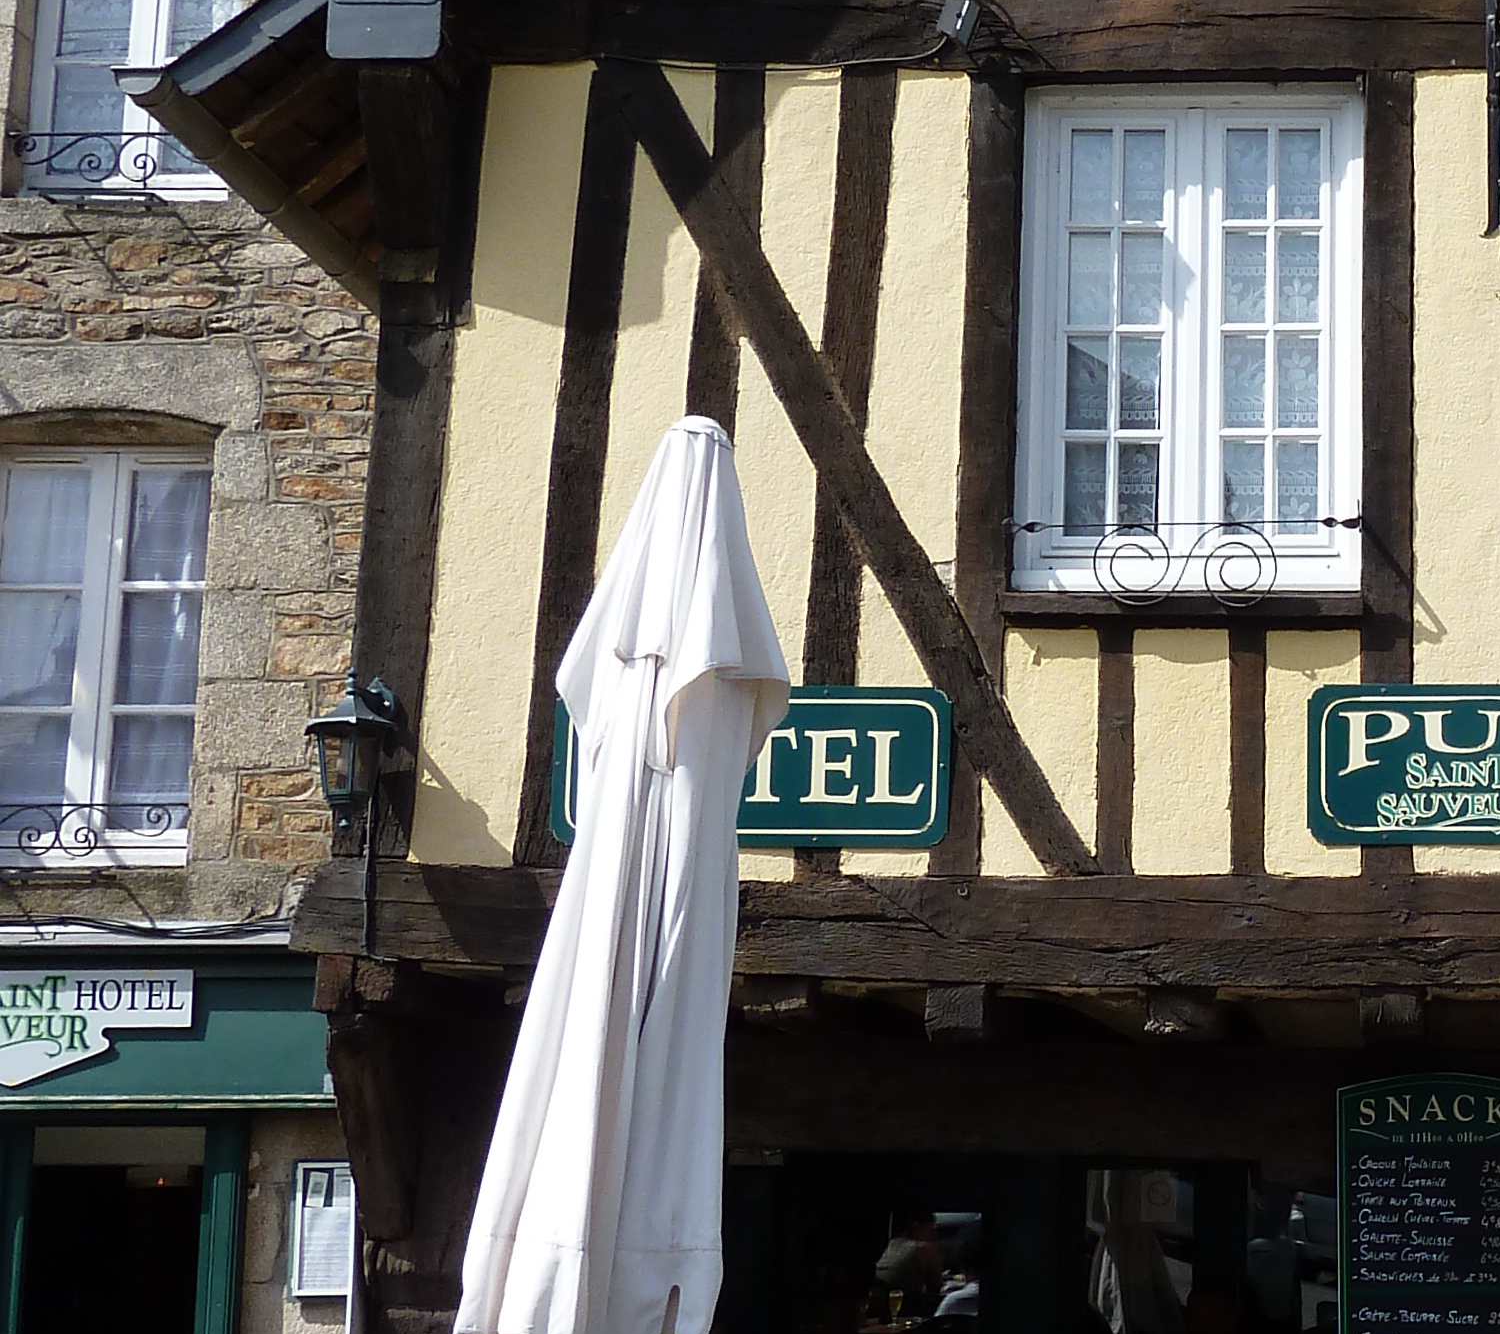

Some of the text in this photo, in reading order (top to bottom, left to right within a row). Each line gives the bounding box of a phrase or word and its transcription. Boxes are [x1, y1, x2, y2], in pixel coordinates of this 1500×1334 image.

[745, 727, 925, 805] TEL
[0, 976, 185, 1011] INT HOTEL
[0, 1015, 90, 1051] VEUR
[1358, 1174, 1397, 1188] QUICHE
[1359, 1244, 1397, 1261] SALADE
